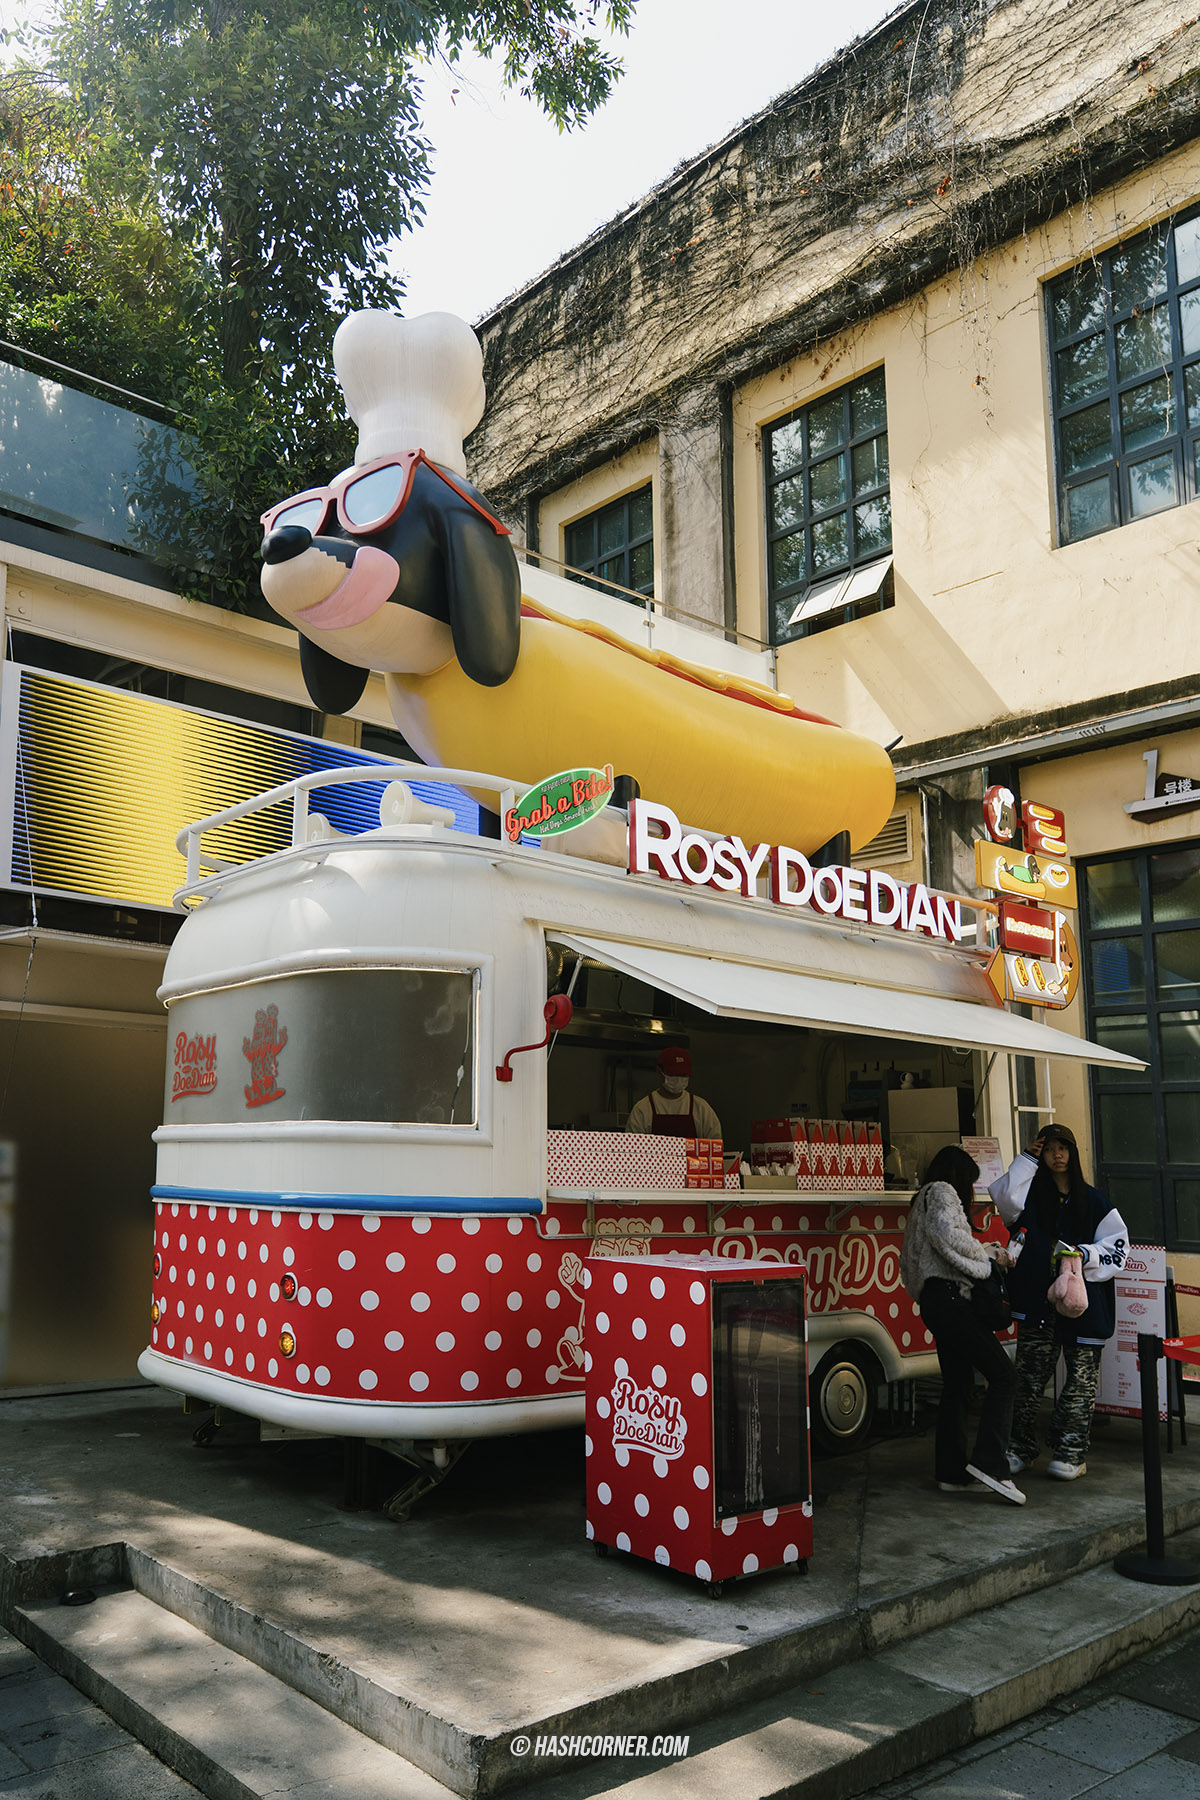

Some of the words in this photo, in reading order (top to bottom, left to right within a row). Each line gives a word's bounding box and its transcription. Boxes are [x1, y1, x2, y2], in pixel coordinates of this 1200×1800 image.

[505, 795, 556, 842] Grab
[556, 796, 572, 813] a
[570, 765, 612, 806] Bite!
[1164, 778, 1192, 796] 号楼
[629, 798, 771, 897] ROSY
[173, 1031, 217, 1072] Rosy
[172, 1067, 217, 1093] DoeDian
[616, 1378, 681, 1435] Rosy
[615, 1415, 683, 1450] DoeDian
